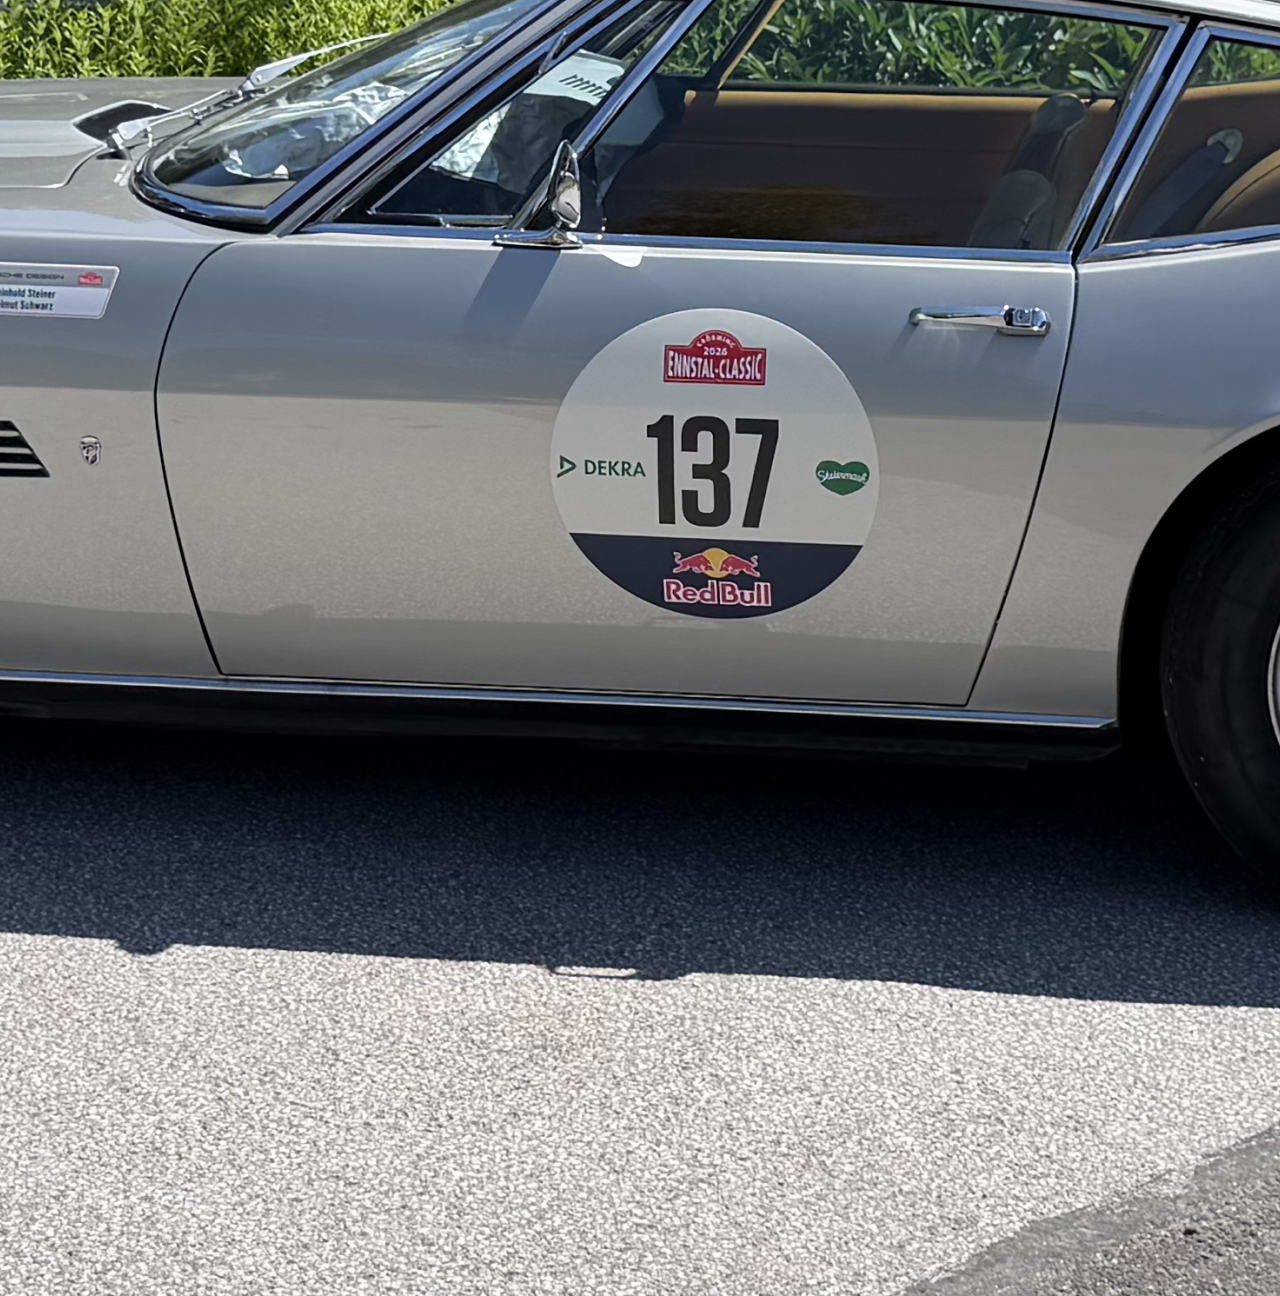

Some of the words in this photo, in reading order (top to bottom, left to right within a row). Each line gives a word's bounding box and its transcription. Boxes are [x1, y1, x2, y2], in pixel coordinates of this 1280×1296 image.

[27, 289, 56, 299] Steiner
[20, 301, 54, 311] Schwarz
[667, 350, 763, 380] ENNSTAL-CLASSIC
[584, 460, 646, 477] DEKRA
[646, 414, 780, 528] 137
[664, 580, 718, 602] Red
[720, 583, 772, 606] Bull
